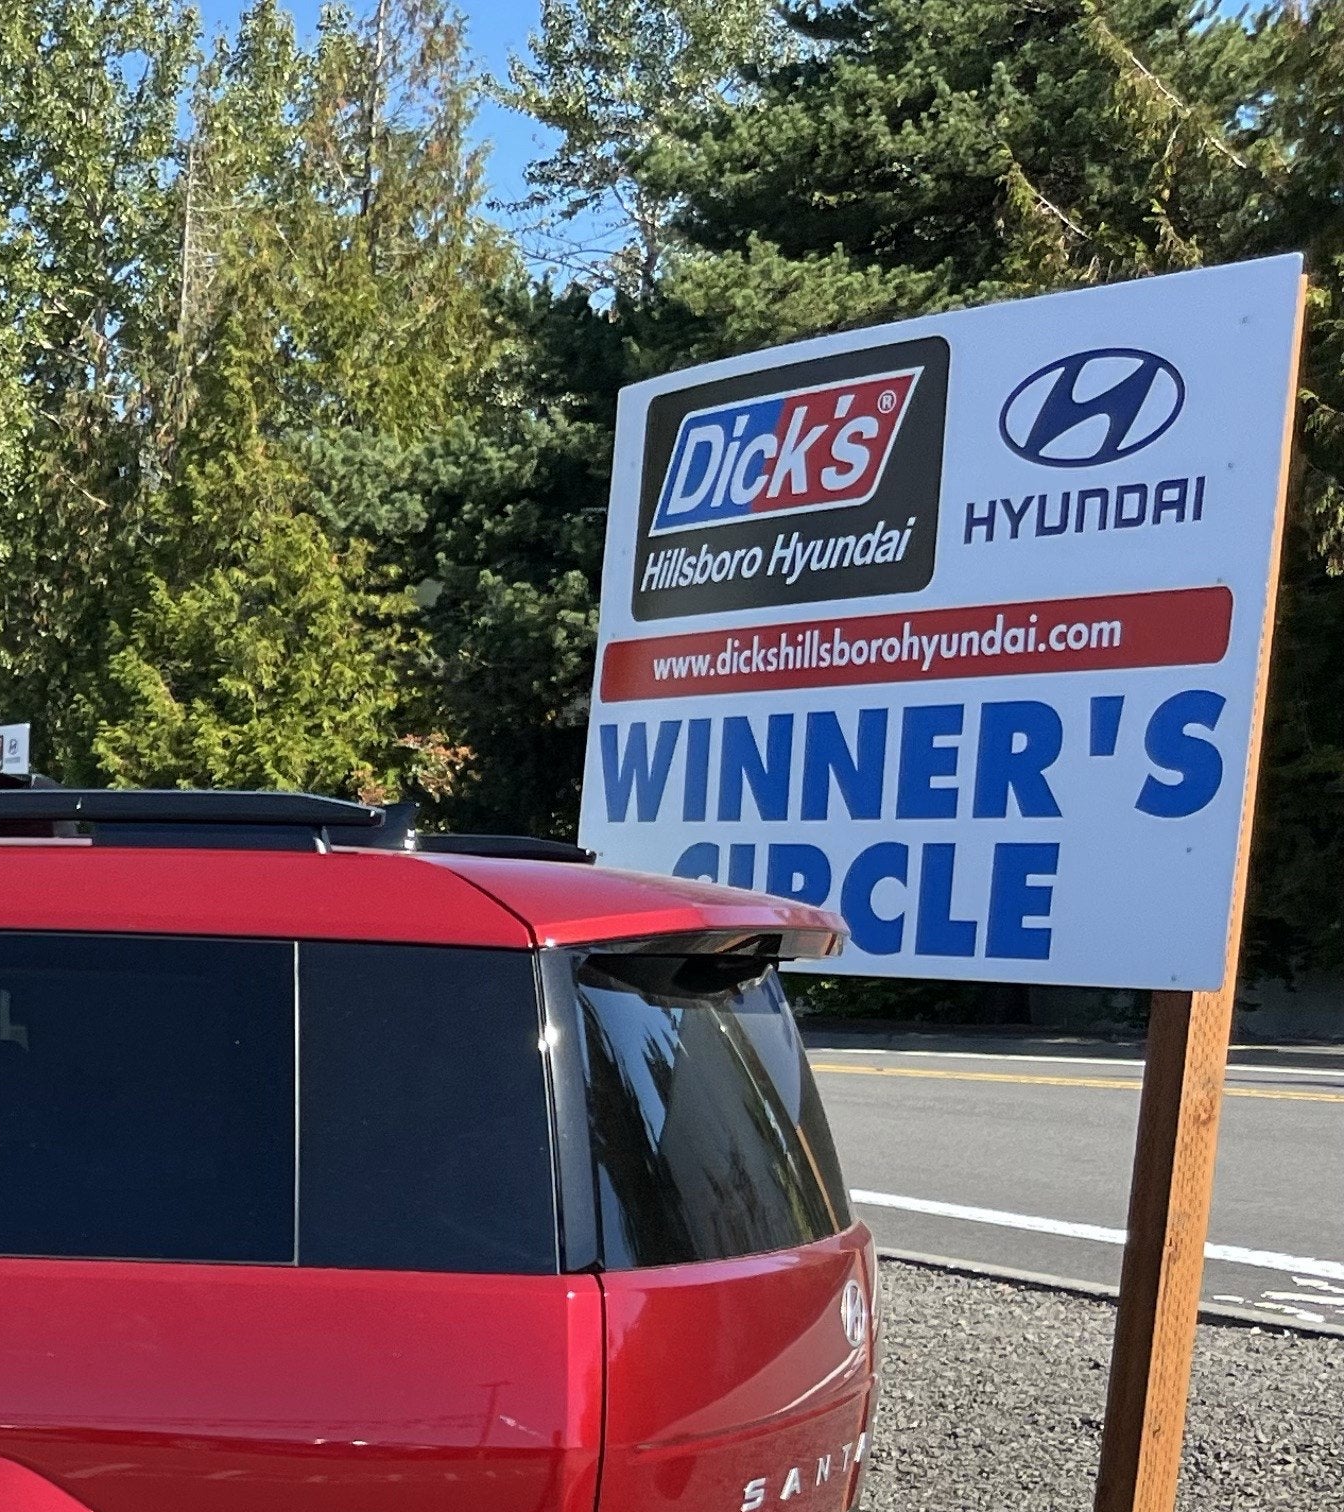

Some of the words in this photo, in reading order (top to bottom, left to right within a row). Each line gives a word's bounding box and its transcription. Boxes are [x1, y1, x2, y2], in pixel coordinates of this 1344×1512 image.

[665, 392, 880, 516] Dick's
[963, 475, 1207, 545] HYUNDAI
[639, 543, 763, 593] Hillsboro
[765, 516, 917, 586] Hyundai
[652, 613, 1123, 682] www.dickshillsborohyundai.com
[598, 689, 1228, 823] WINNER'S
